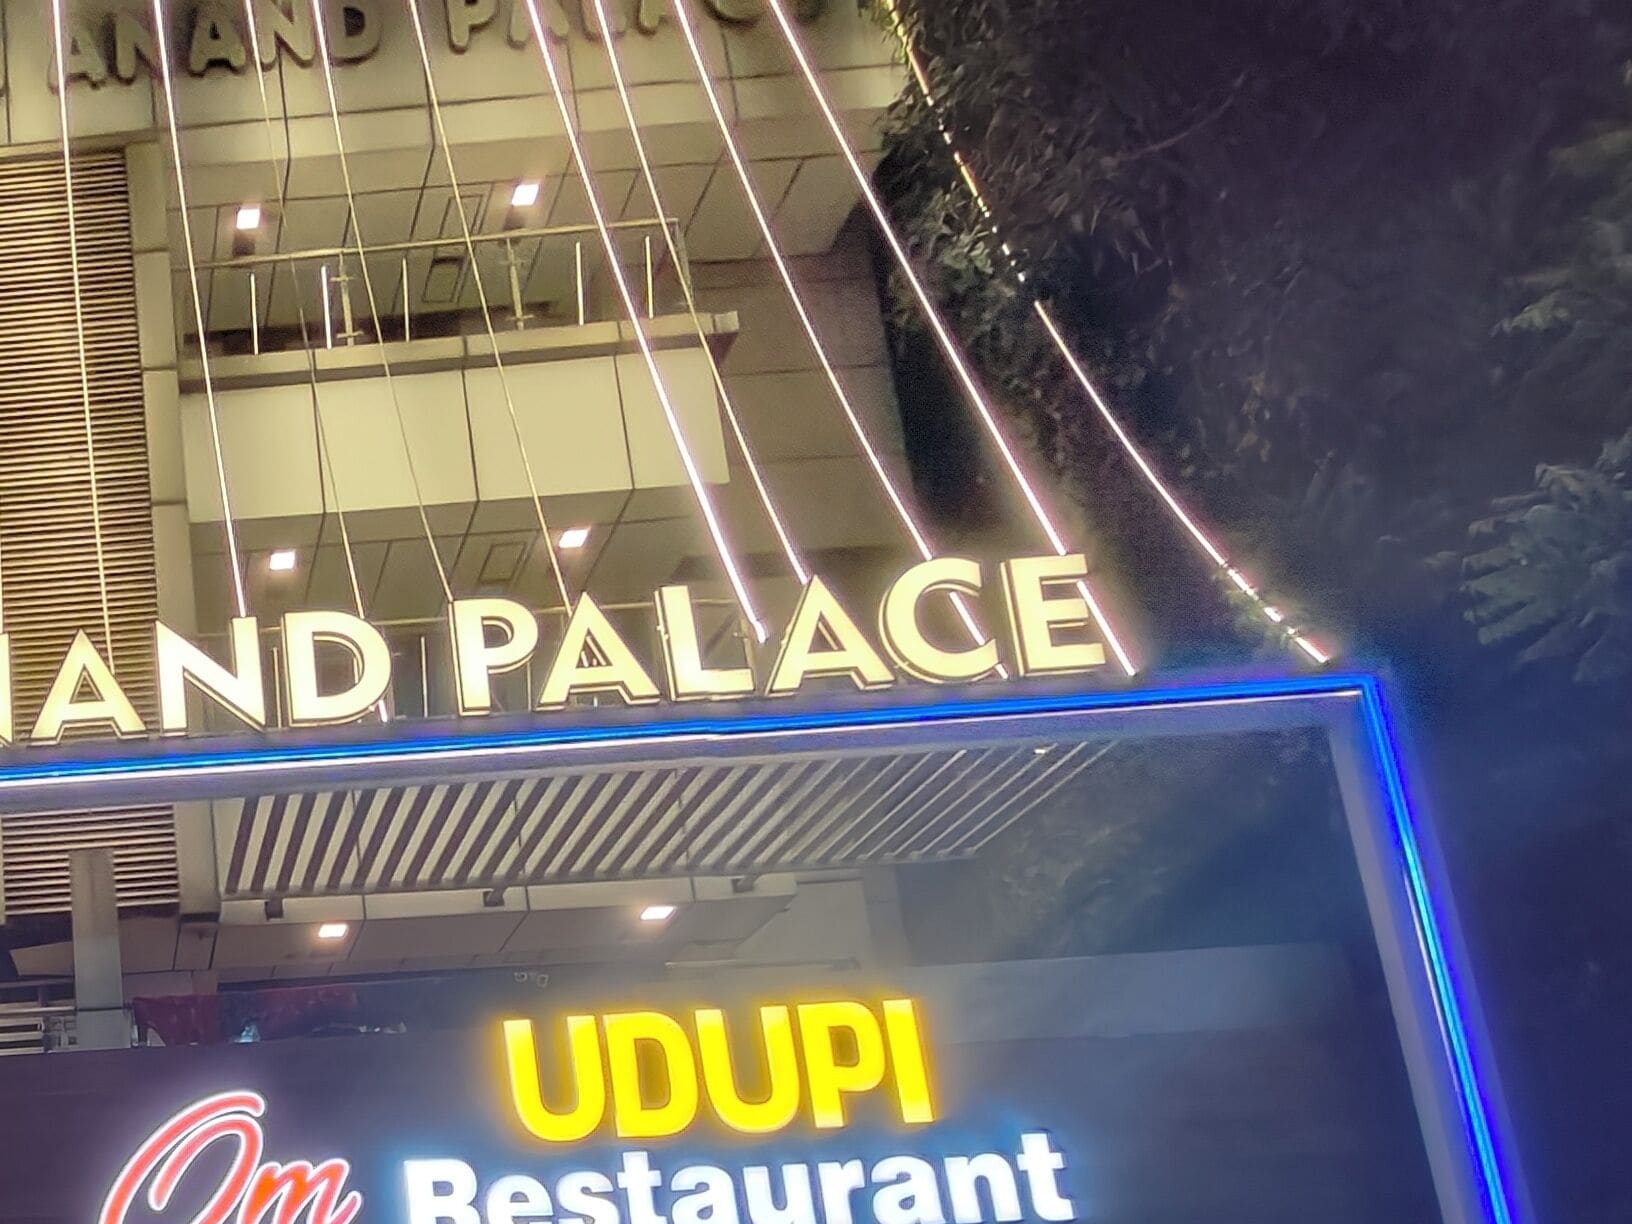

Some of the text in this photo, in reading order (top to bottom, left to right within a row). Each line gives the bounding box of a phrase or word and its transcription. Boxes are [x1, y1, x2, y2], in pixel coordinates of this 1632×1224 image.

[48, 0, 382, 89] ANAND
[450, 553, 1107, 717] PALACE
[504, 999, 937, 1142] UDUPI
